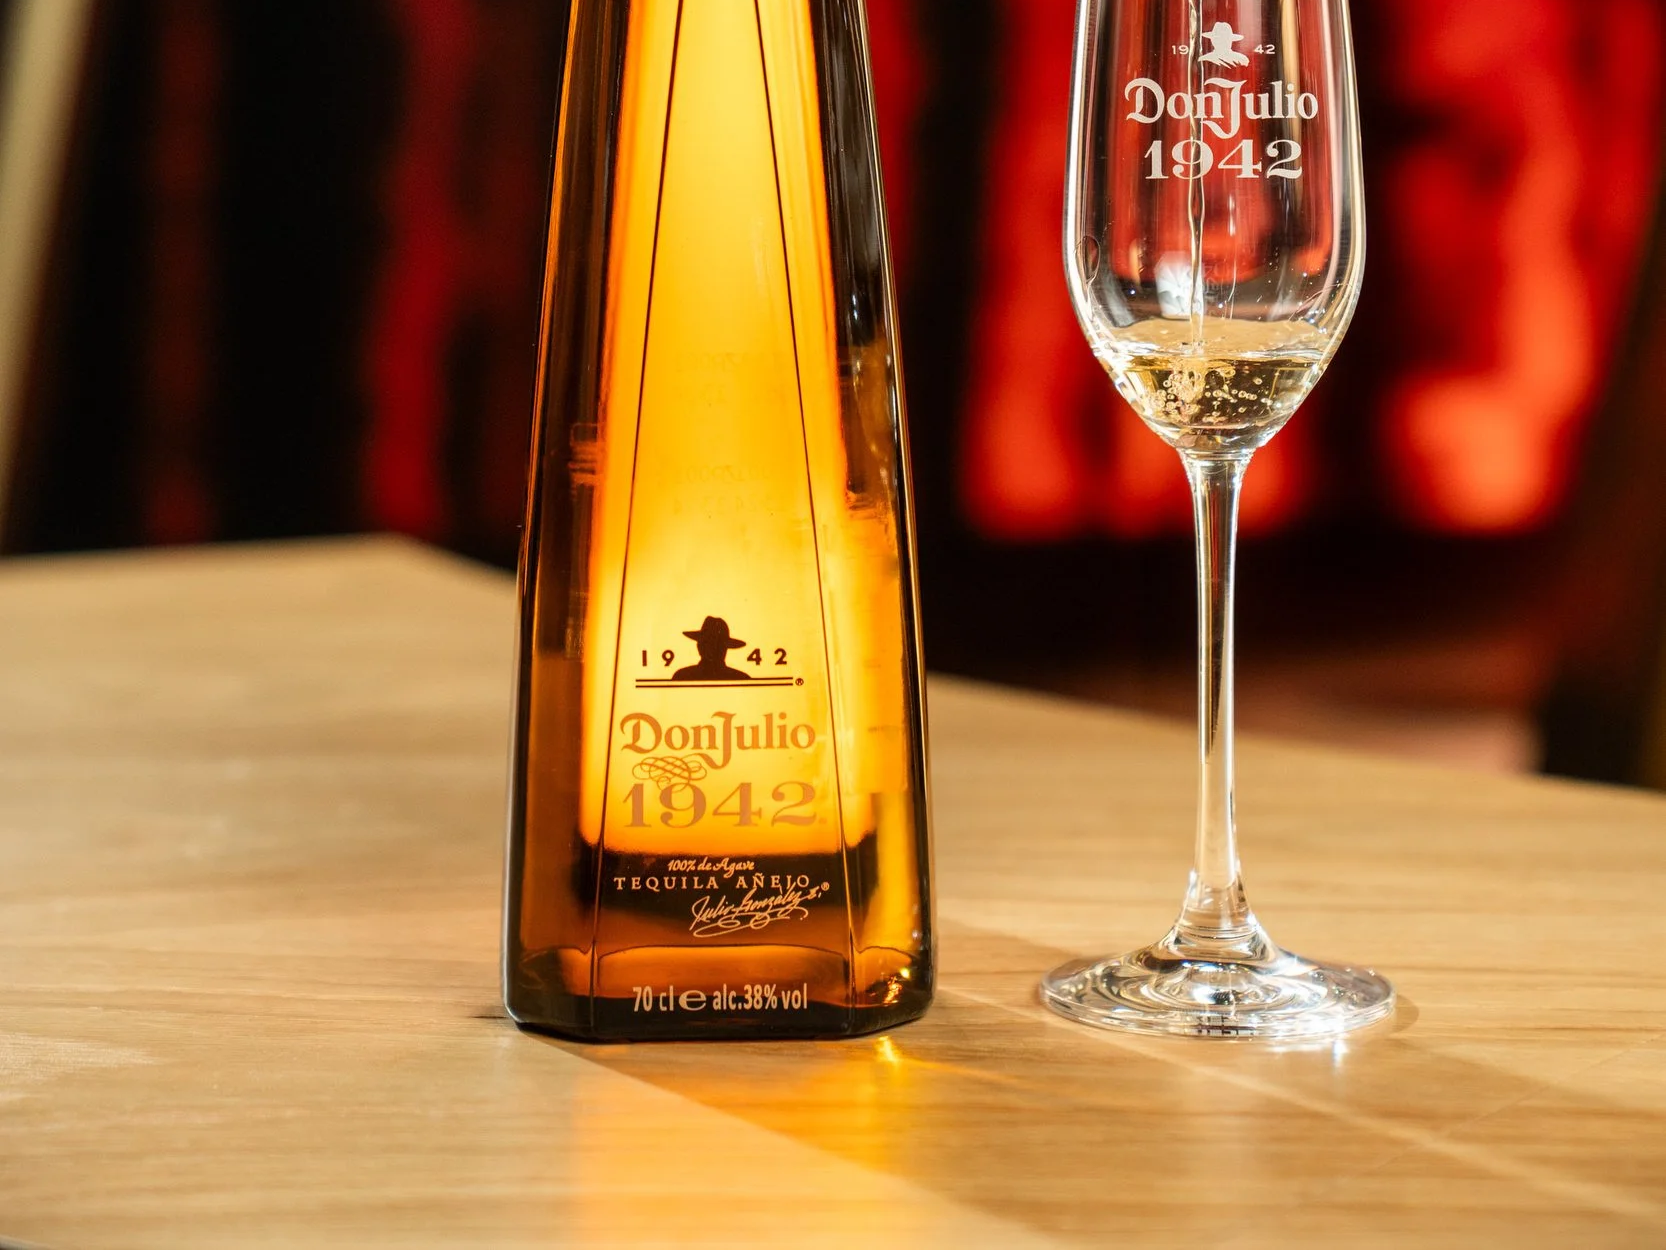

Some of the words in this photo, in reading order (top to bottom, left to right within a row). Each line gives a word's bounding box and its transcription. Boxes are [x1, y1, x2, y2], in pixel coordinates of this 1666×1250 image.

[1144, 139, 1303, 180] 1942
[622, 781, 818, 829] 1942
[613, 876, 720, 892] TEQUILA
[735, 872, 810, 890] AÑEJO
[667, 858, 696, 872] 100%
[697, 856, 713, 872] de
[713, 857, 755, 879] Agave
[632, 986, 653, 1012] 70
[659, 985, 675, 1012] cl
[781, 982, 808, 1010] vol
